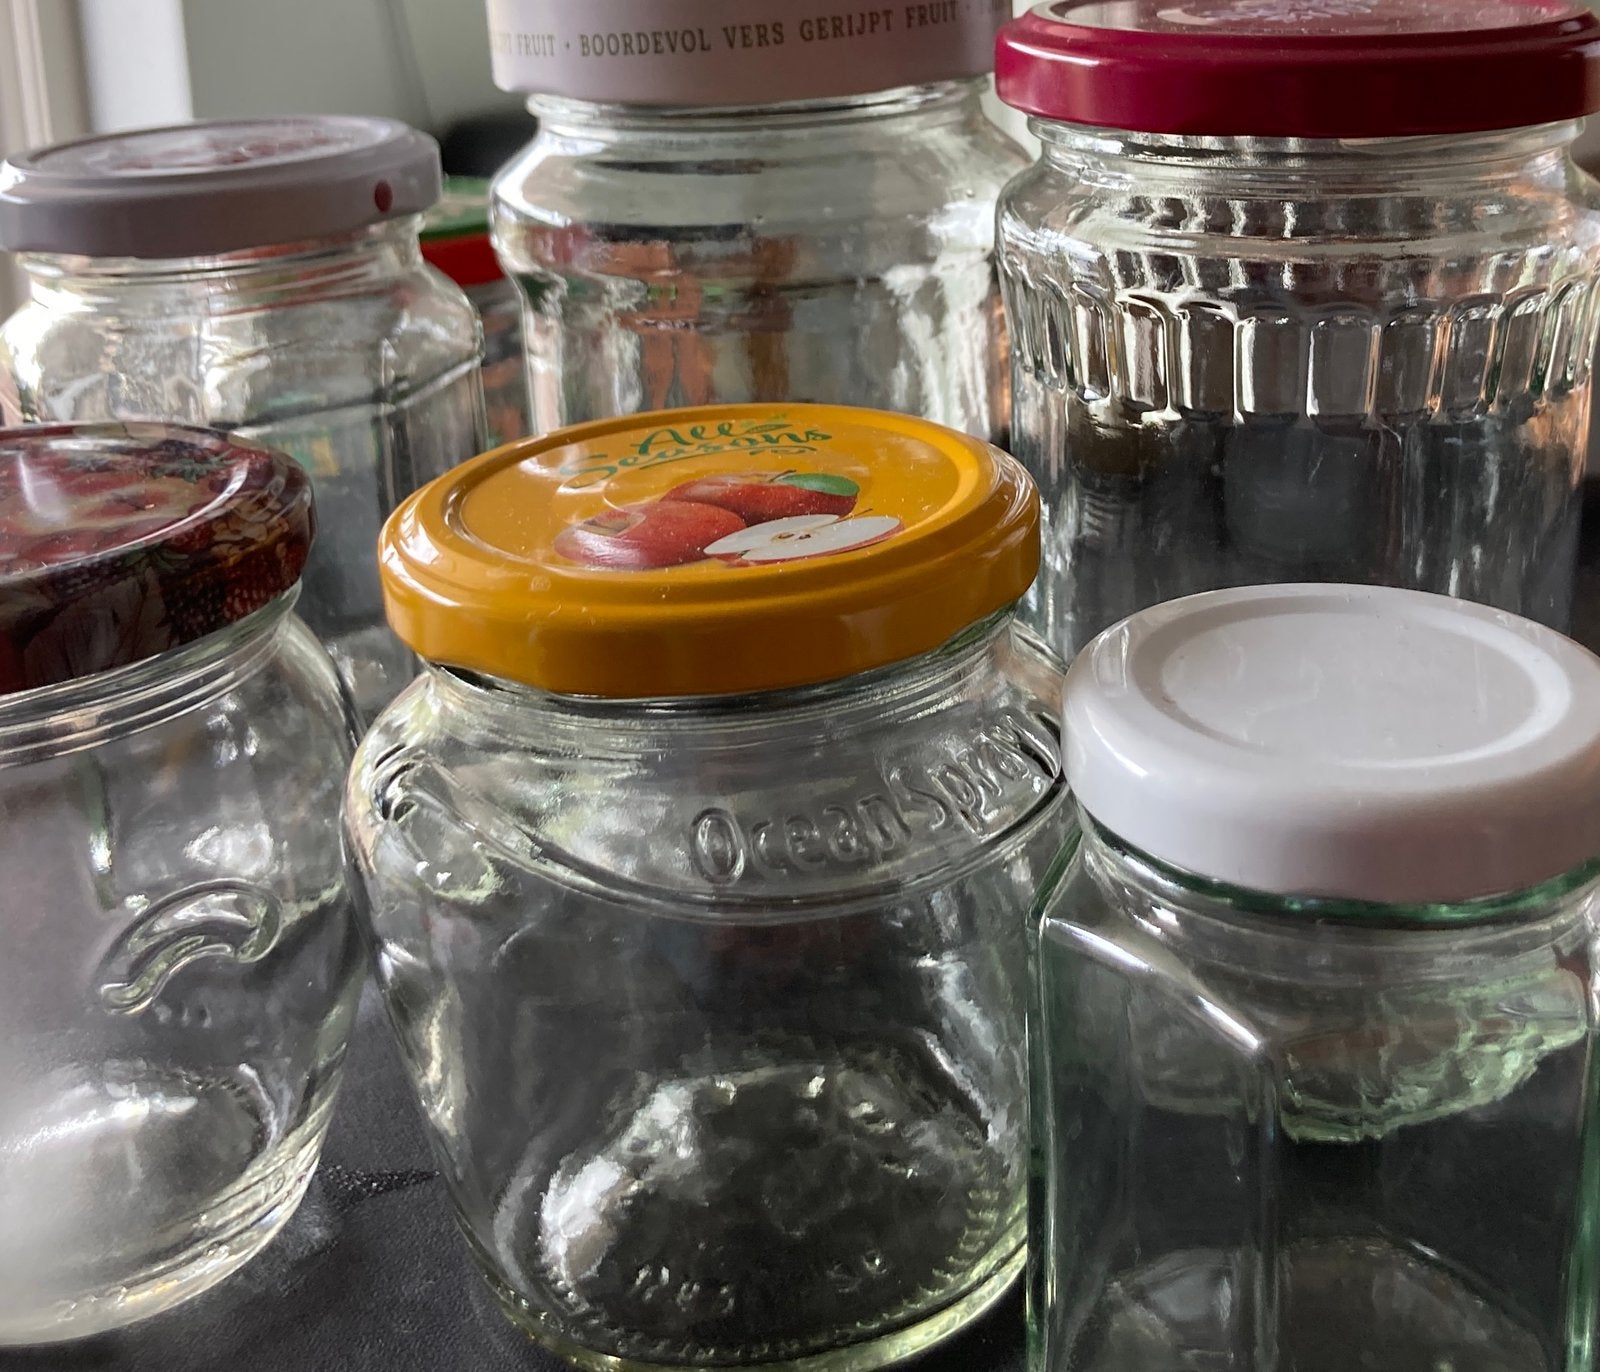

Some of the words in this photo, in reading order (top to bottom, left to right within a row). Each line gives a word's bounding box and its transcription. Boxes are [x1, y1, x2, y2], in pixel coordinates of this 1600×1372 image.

[517, 33, 556, 56] FRUIT
[579, 30, 711, 56] BOORDEVOL
[722, 23, 784, 48] VERS
[799, 10, 894, 42] GERIJPT
[905, 0, 957, 28] FRUIT
[690, 793, 913, 886] Ocean
